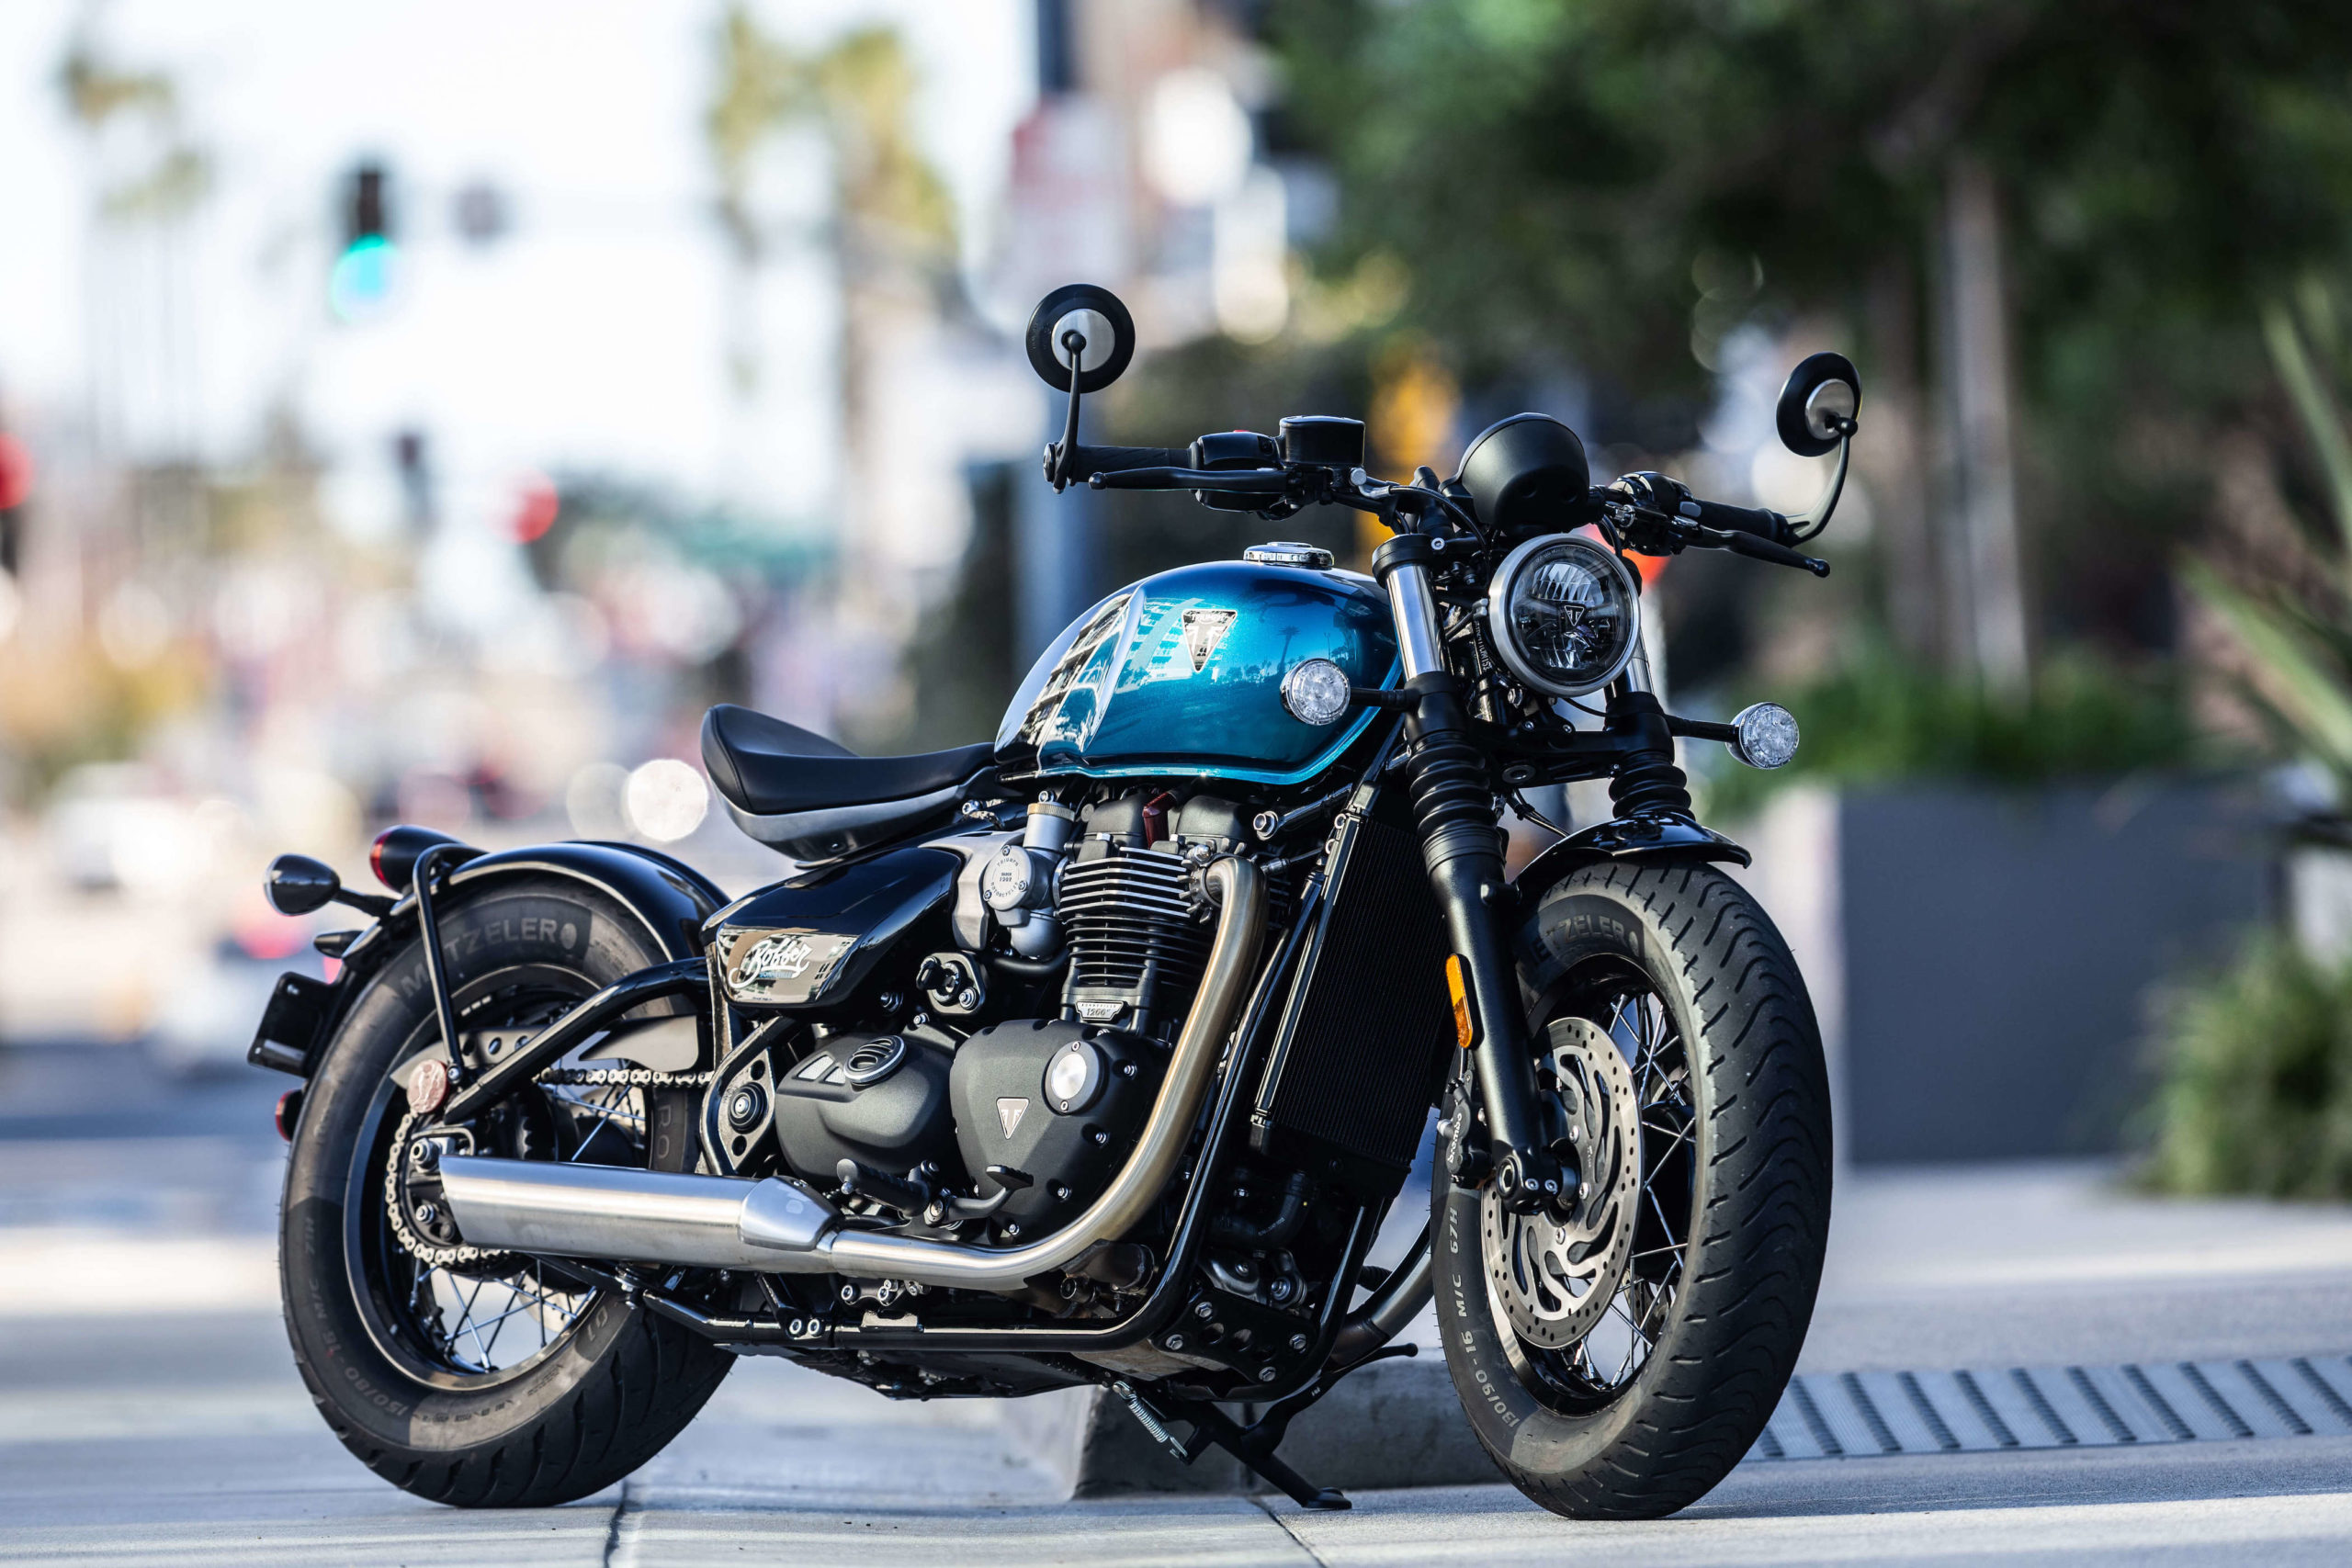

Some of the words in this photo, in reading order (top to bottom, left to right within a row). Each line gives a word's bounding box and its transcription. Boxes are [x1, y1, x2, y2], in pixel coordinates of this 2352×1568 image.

[401, 917, 558, 998] MTZELER
[728, 935, 813, 989] Bobber
[1447, 1112, 1463, 1164] brembo
[1449, 1207, 1459, 1254] 67H
[1452, 1273, 1468, 1318] M/C
